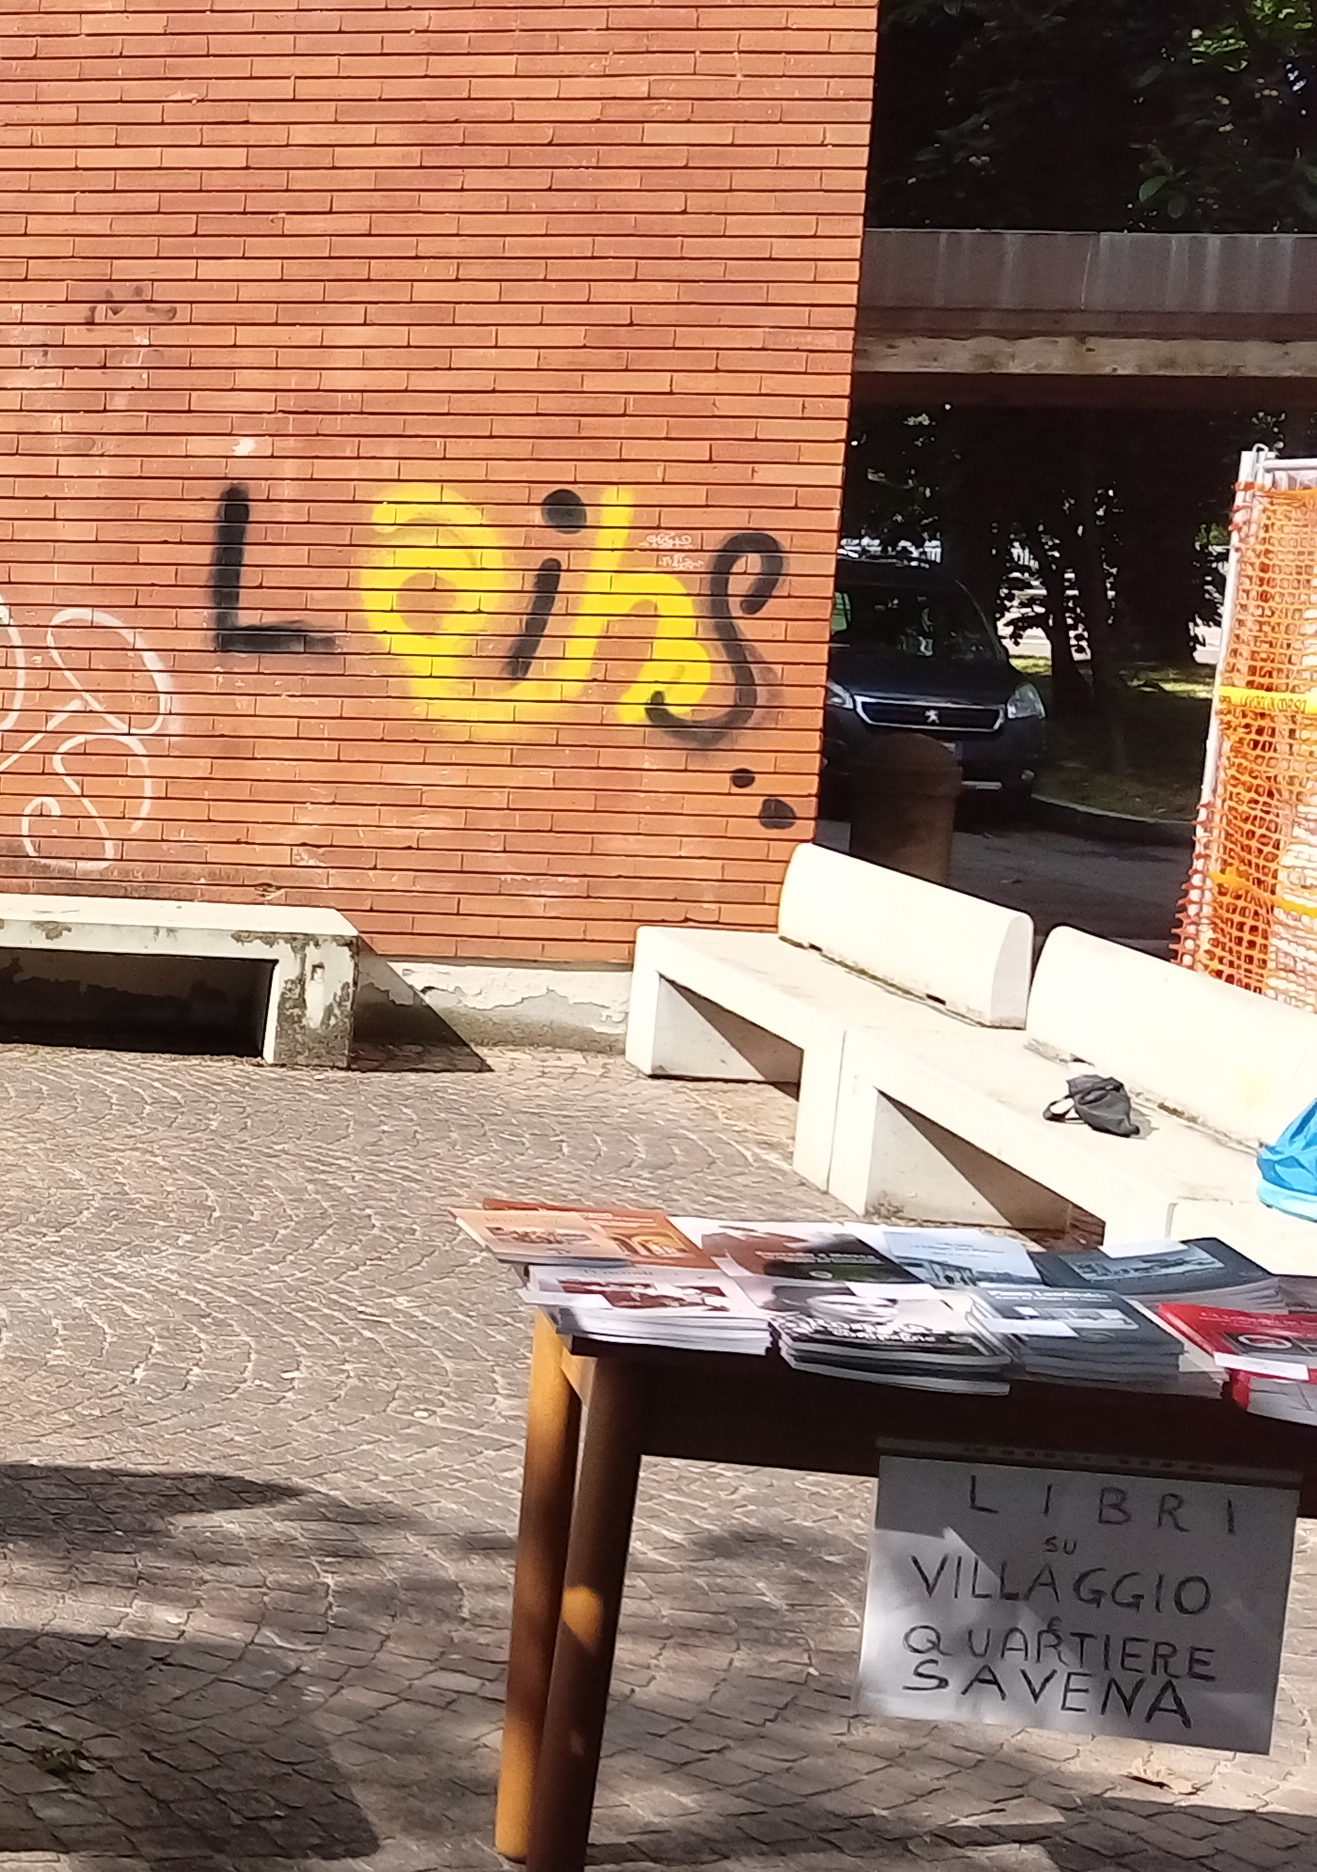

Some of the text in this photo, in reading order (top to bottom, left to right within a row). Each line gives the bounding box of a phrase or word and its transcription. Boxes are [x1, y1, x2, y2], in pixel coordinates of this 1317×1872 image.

[968, 1474, 1238, 1536] LIBRI
[910, 1553, 1213, 1618] VILLAGGIO
[902, 1623, 1218, 1686] QUARTIERE
[901, 1658, 1195, 1730] SAVENA
